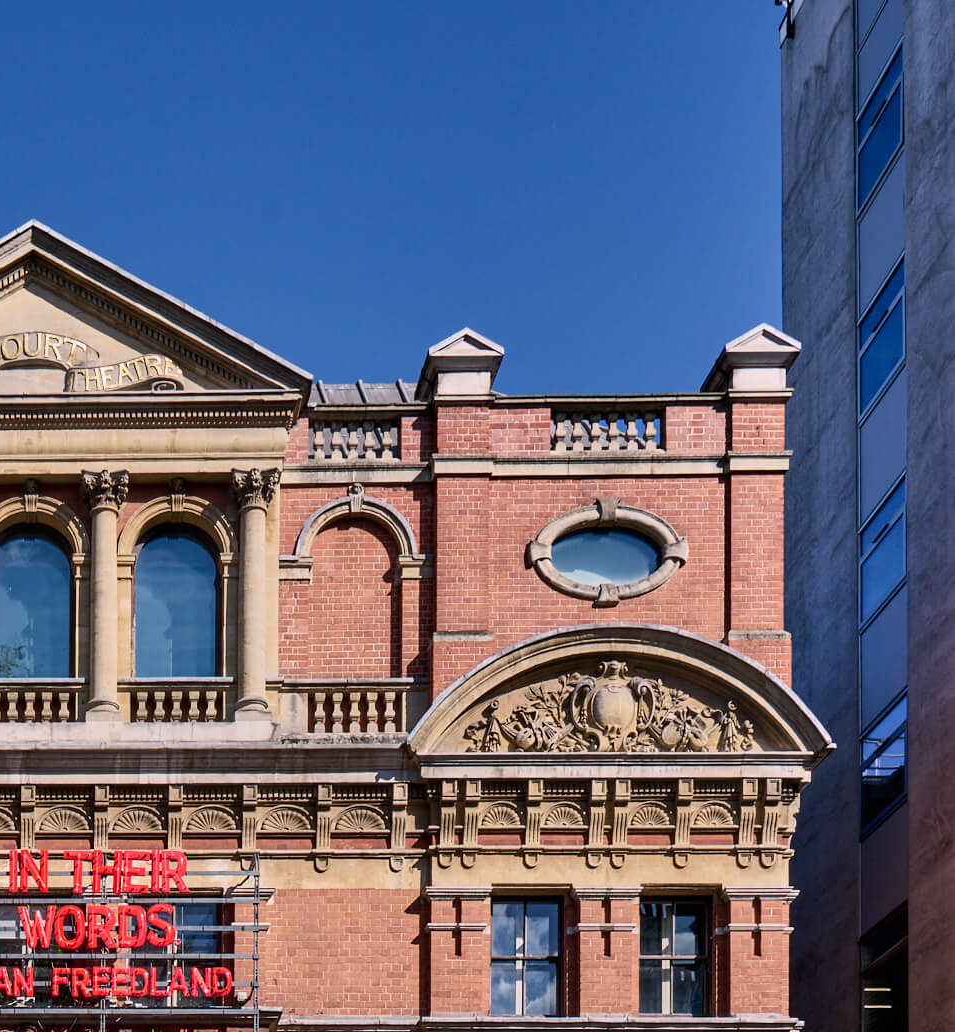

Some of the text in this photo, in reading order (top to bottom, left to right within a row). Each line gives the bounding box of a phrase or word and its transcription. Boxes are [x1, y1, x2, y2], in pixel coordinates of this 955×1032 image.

[68, 353, 184, 392] THEATRE
[9, 849, 49, 894] IN
[63, 849, 190, 894] THEIR
[51, 966, 233, 998] FREEDLAND
